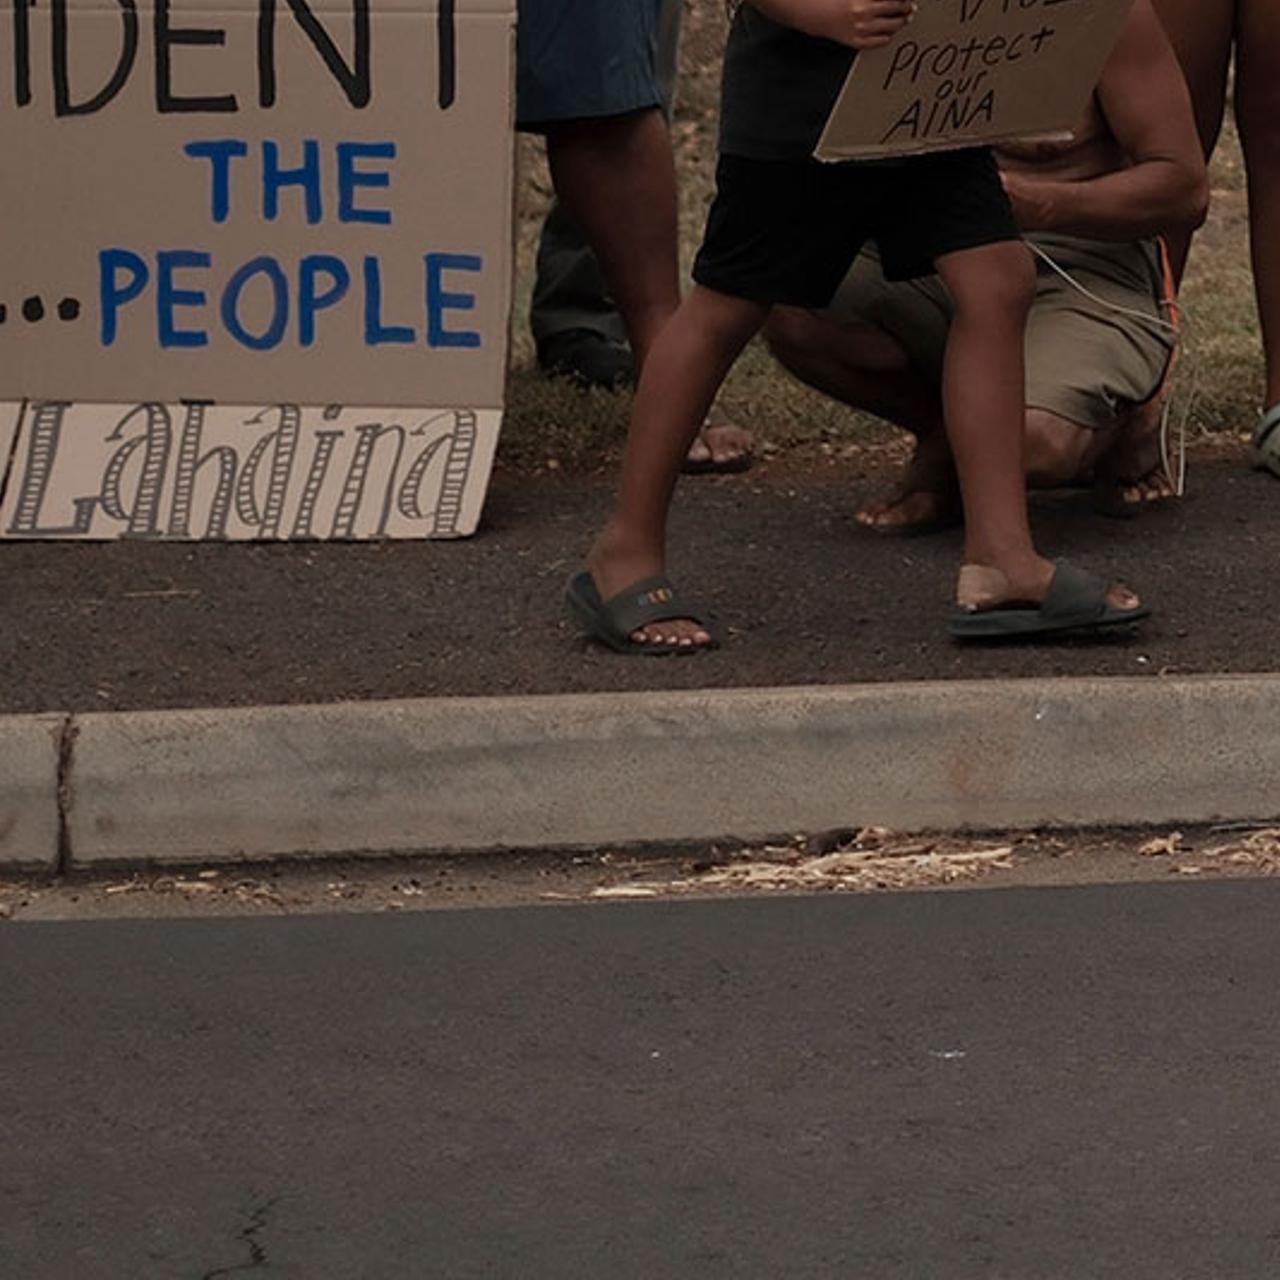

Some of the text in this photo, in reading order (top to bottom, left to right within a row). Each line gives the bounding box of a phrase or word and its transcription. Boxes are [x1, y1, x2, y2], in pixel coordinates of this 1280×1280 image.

[878, 88, 995, 145] AINA
[934, 69, 988, 101] our
[184, 139, 397, 226] THE
[5, 398, 478, 541] Lahaina
